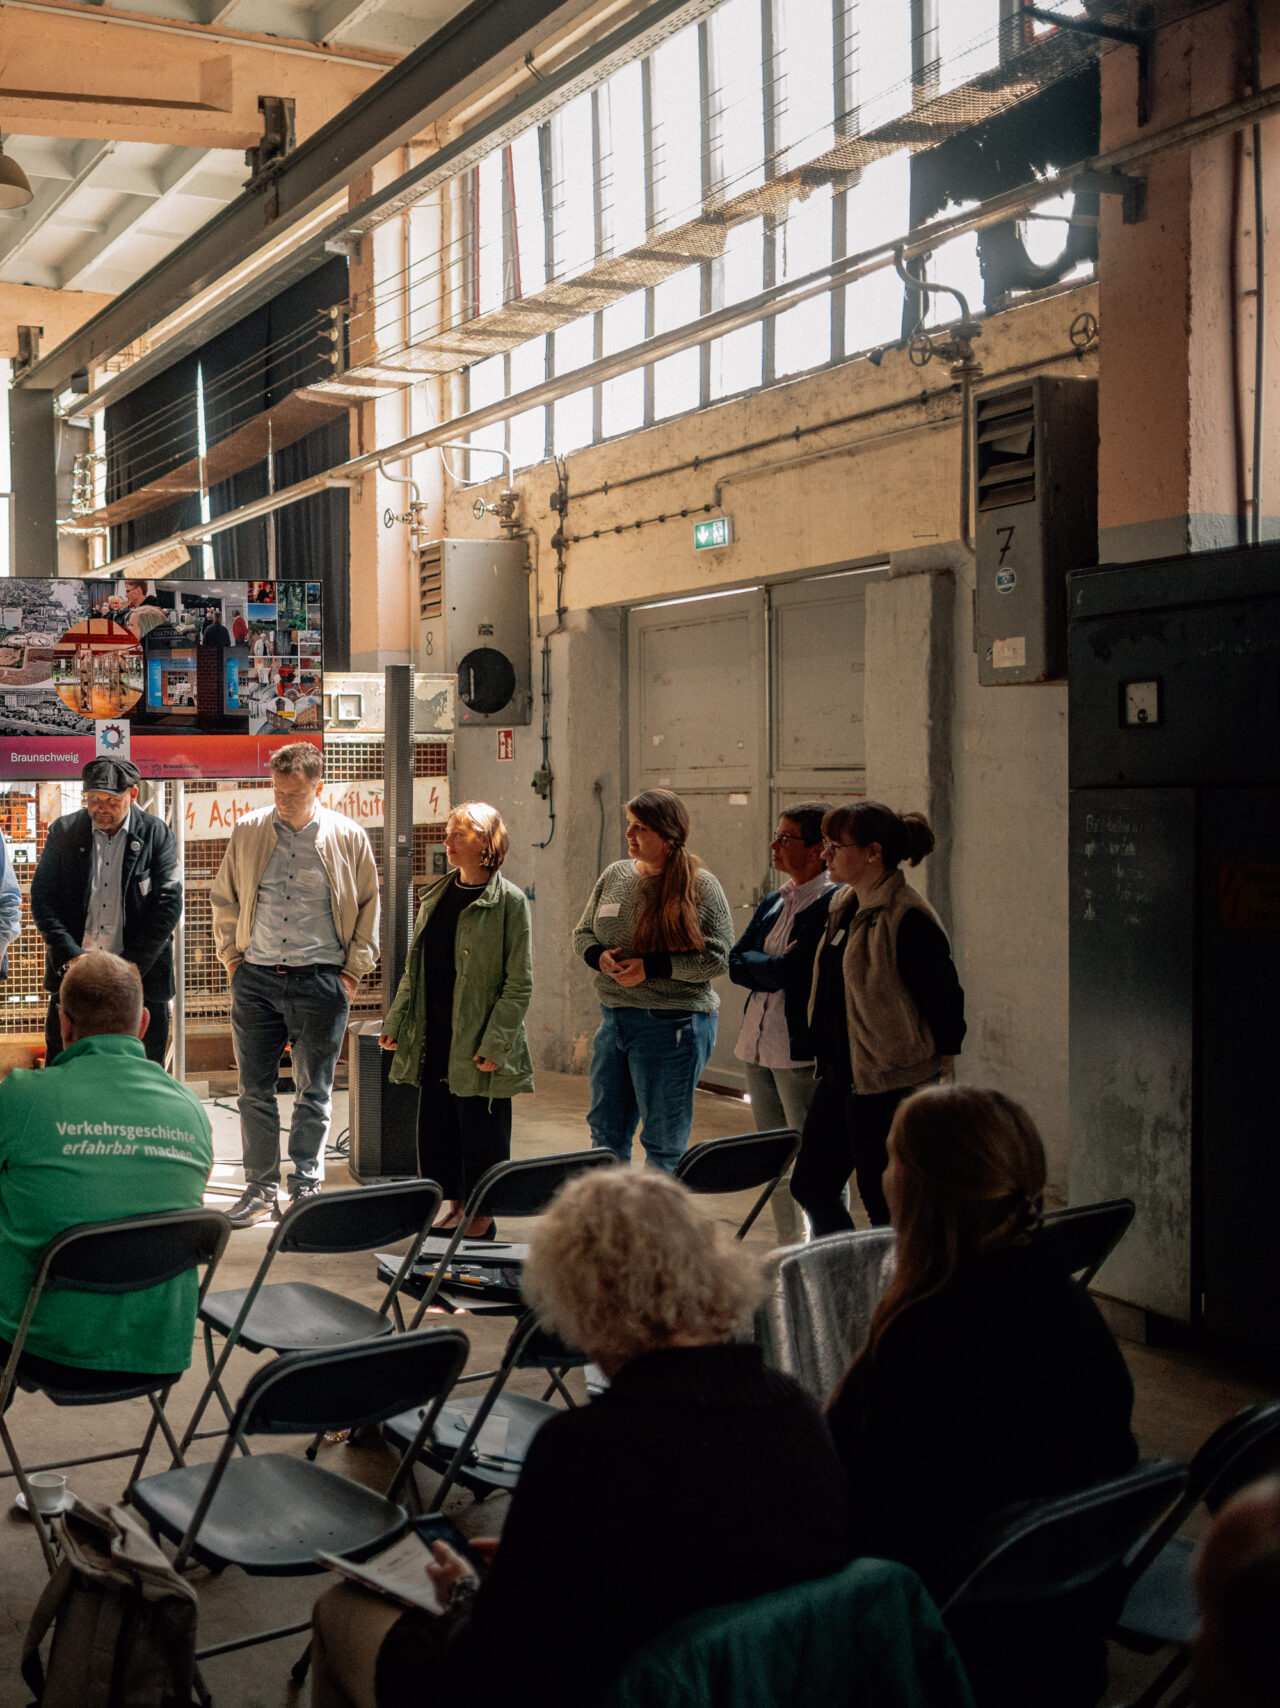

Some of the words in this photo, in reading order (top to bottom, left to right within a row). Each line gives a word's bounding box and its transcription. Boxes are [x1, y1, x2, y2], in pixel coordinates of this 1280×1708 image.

[996, 526, 1015, 565] 7
[425, 630, 433, 656] 8
[10, 752, 80, 764] Braunschweig
[208, 799, 255, 829] Acht
[56, 1120, 196, 1144] Verkehrsgeschichte
[62, 1140, 139, 1156] erfahrbar
[144, 1145, 193, 1160] machen
